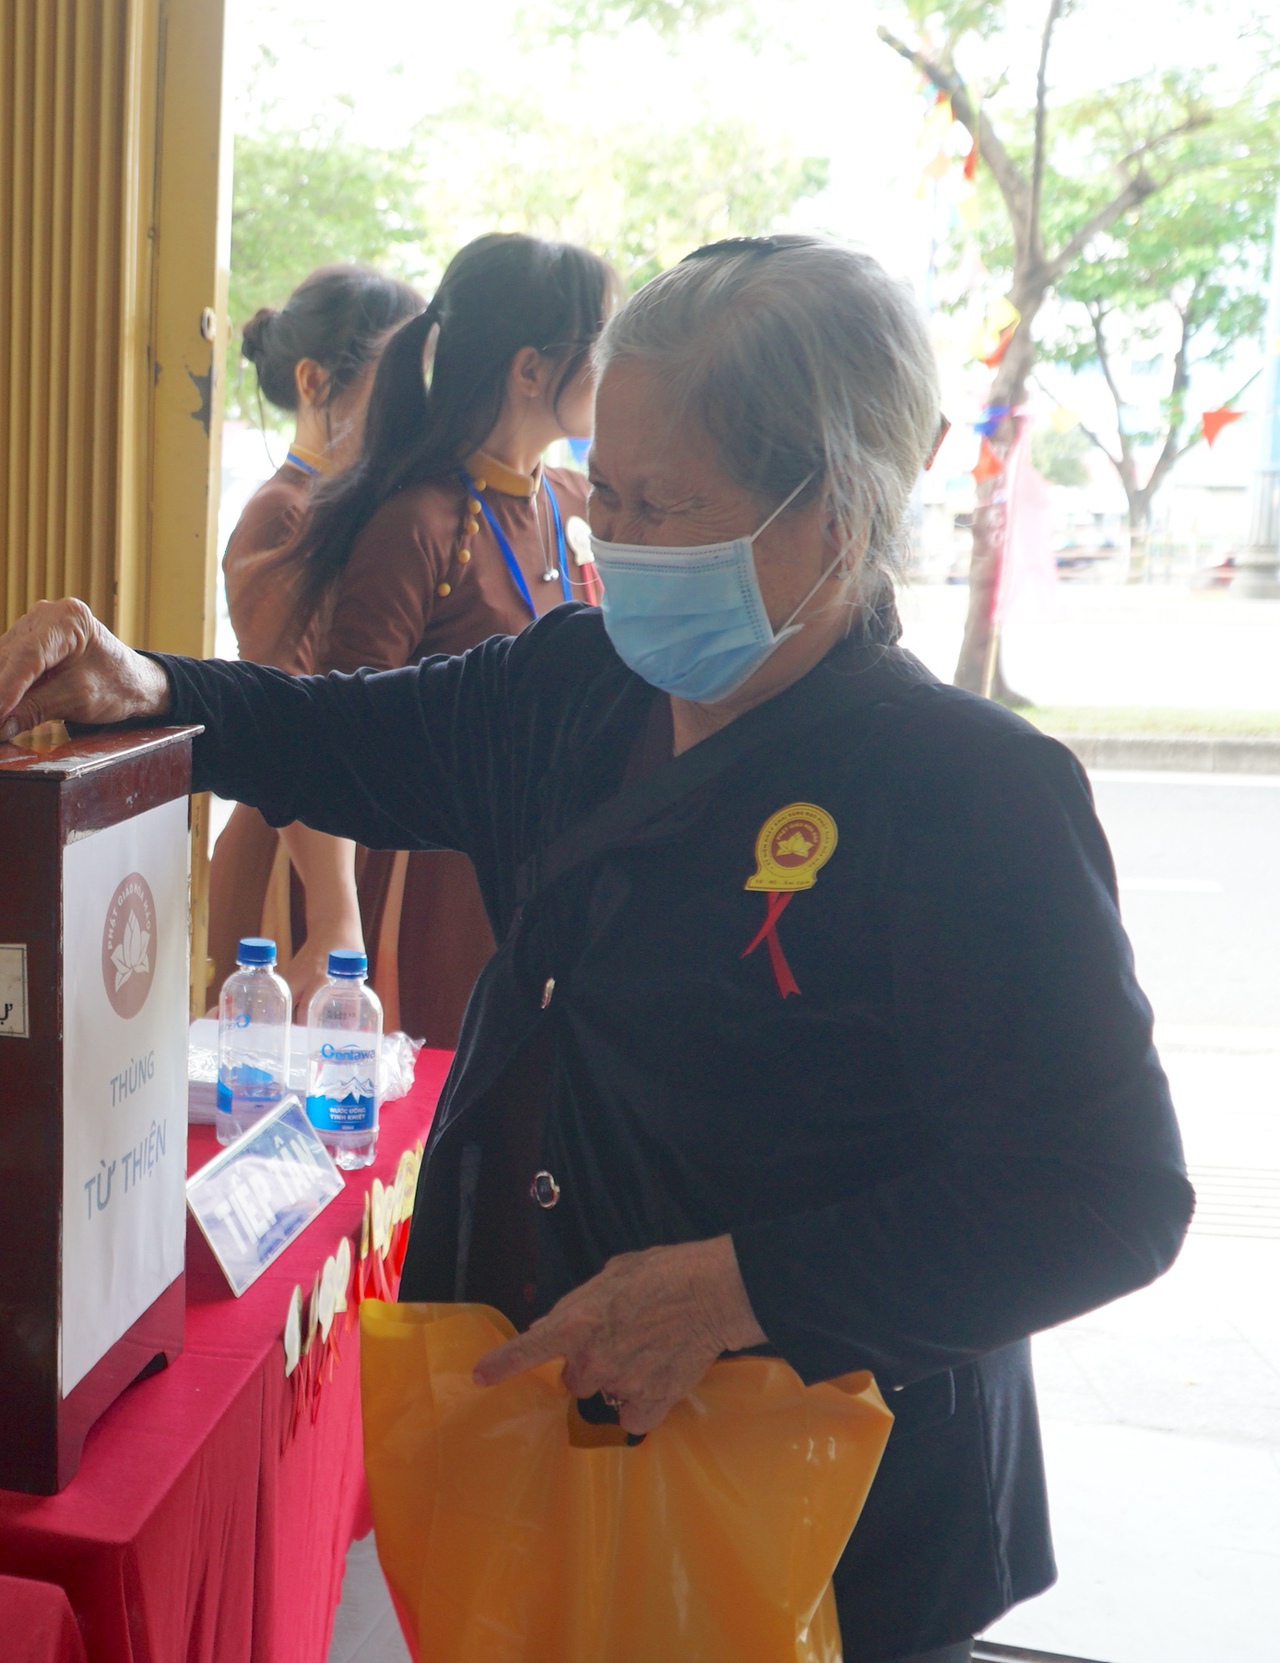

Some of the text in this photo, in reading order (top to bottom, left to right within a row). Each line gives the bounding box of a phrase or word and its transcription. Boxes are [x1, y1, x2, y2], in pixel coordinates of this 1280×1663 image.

[108, 907, 118, 950] PHẬT
[118, 884, 134, 906] GIÁO
[134, 883, 144, 902] HÒA
[110, 1050, 155, 1107] THÙNG
[84, 1119, 167, 1220] TỪ THIỆN
[214, 1134, 322, 1255] TIẾP TÂN
